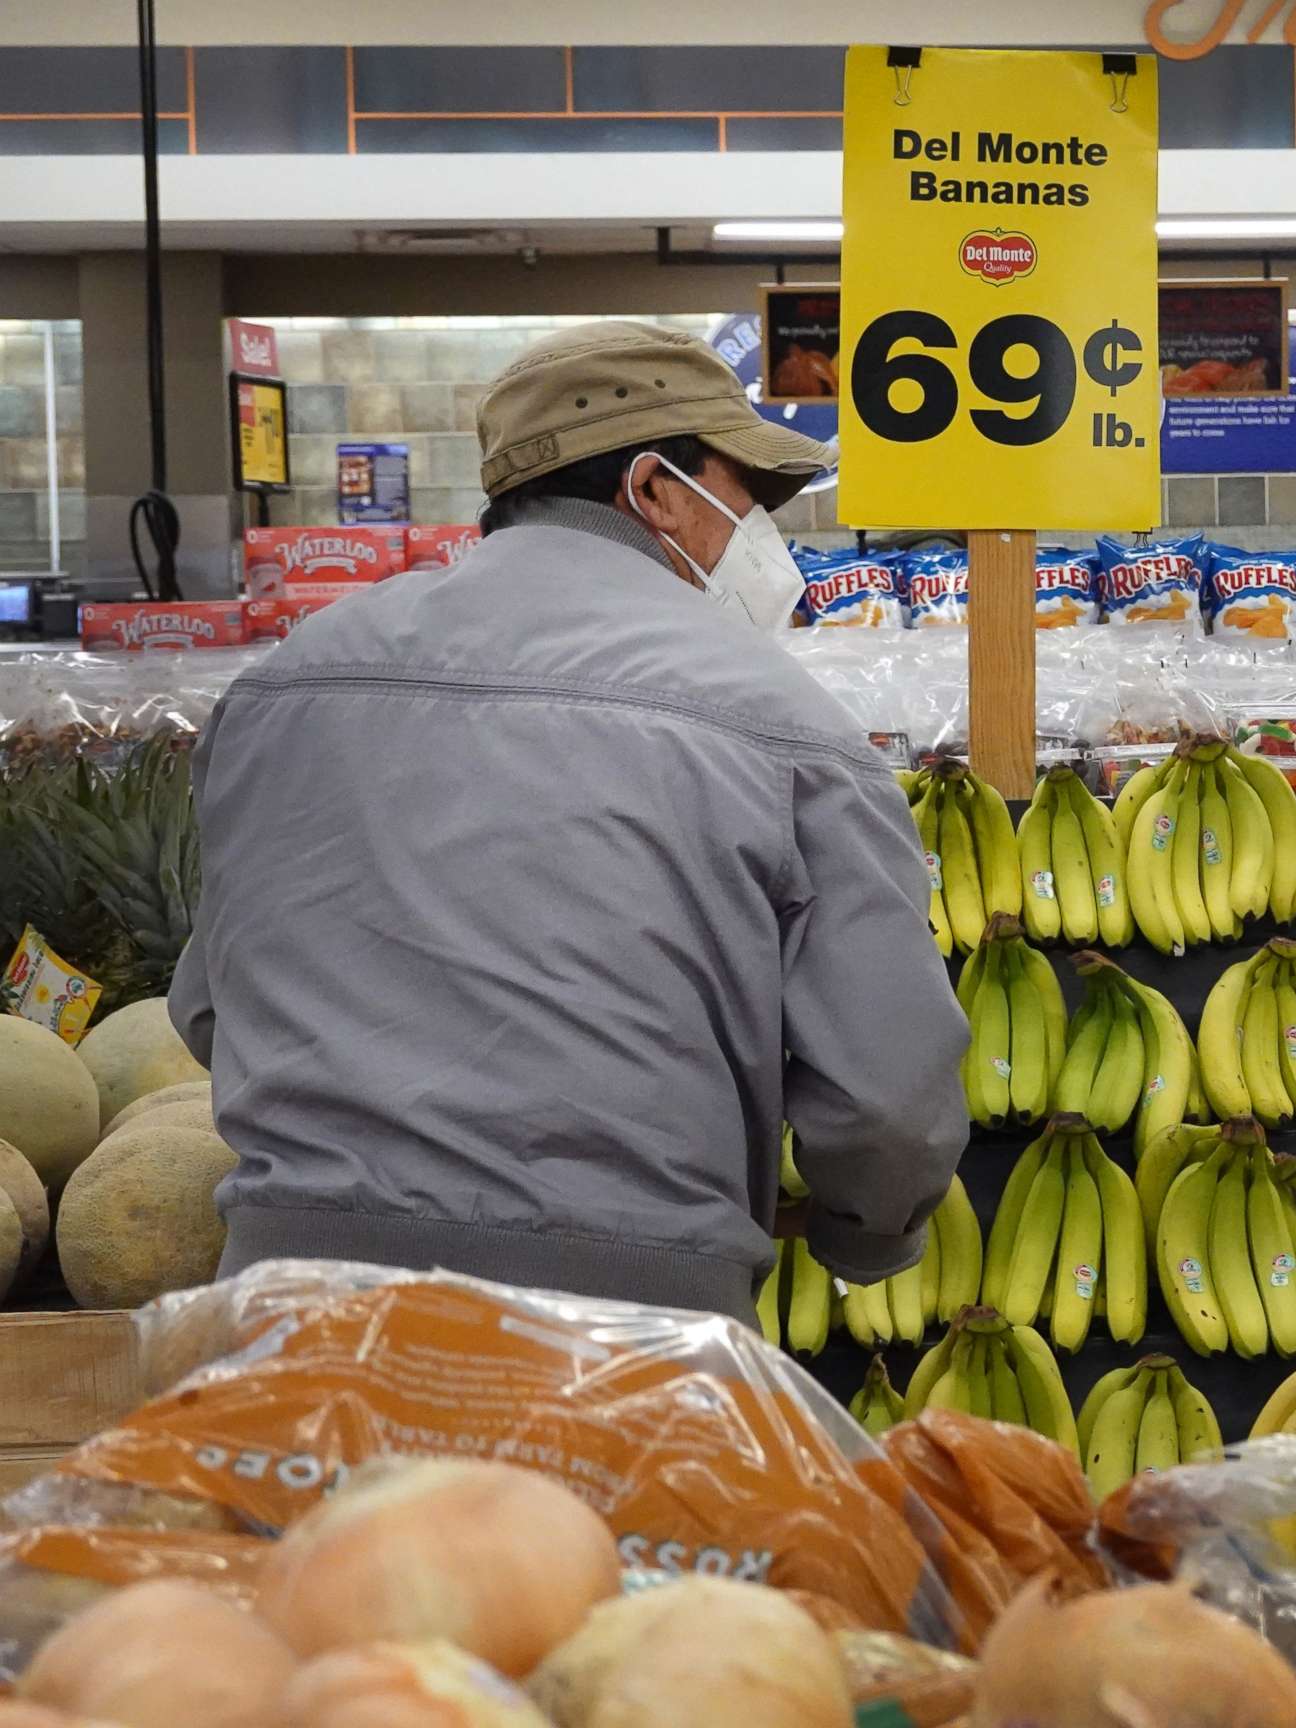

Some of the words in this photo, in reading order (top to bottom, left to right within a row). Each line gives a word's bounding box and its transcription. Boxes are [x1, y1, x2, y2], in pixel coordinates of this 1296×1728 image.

[893, 129, 961, 162] Del
[977, 131, 1108, 166] Monte
[910, 171, 1090, 207] Bananas
[966, 246, 987, 261] Del
[989, 247, 1032, 262] Monte
[984, 262, 1012, 274] Quality
[1092, 413, 1146, 448] lb.
[275, 532, 378, 573] WATERLOO
[807, 566, 892, 611] RUFFLES
[912, 571, 969, 605] RUFF
[1035, 566, 1091, 593] FFLES
[1110, 554, 1196, 600] RUFFLES
[112, 609, 216, 645] WATERLOO
[616, 1533, 773, 1583] RUSS
